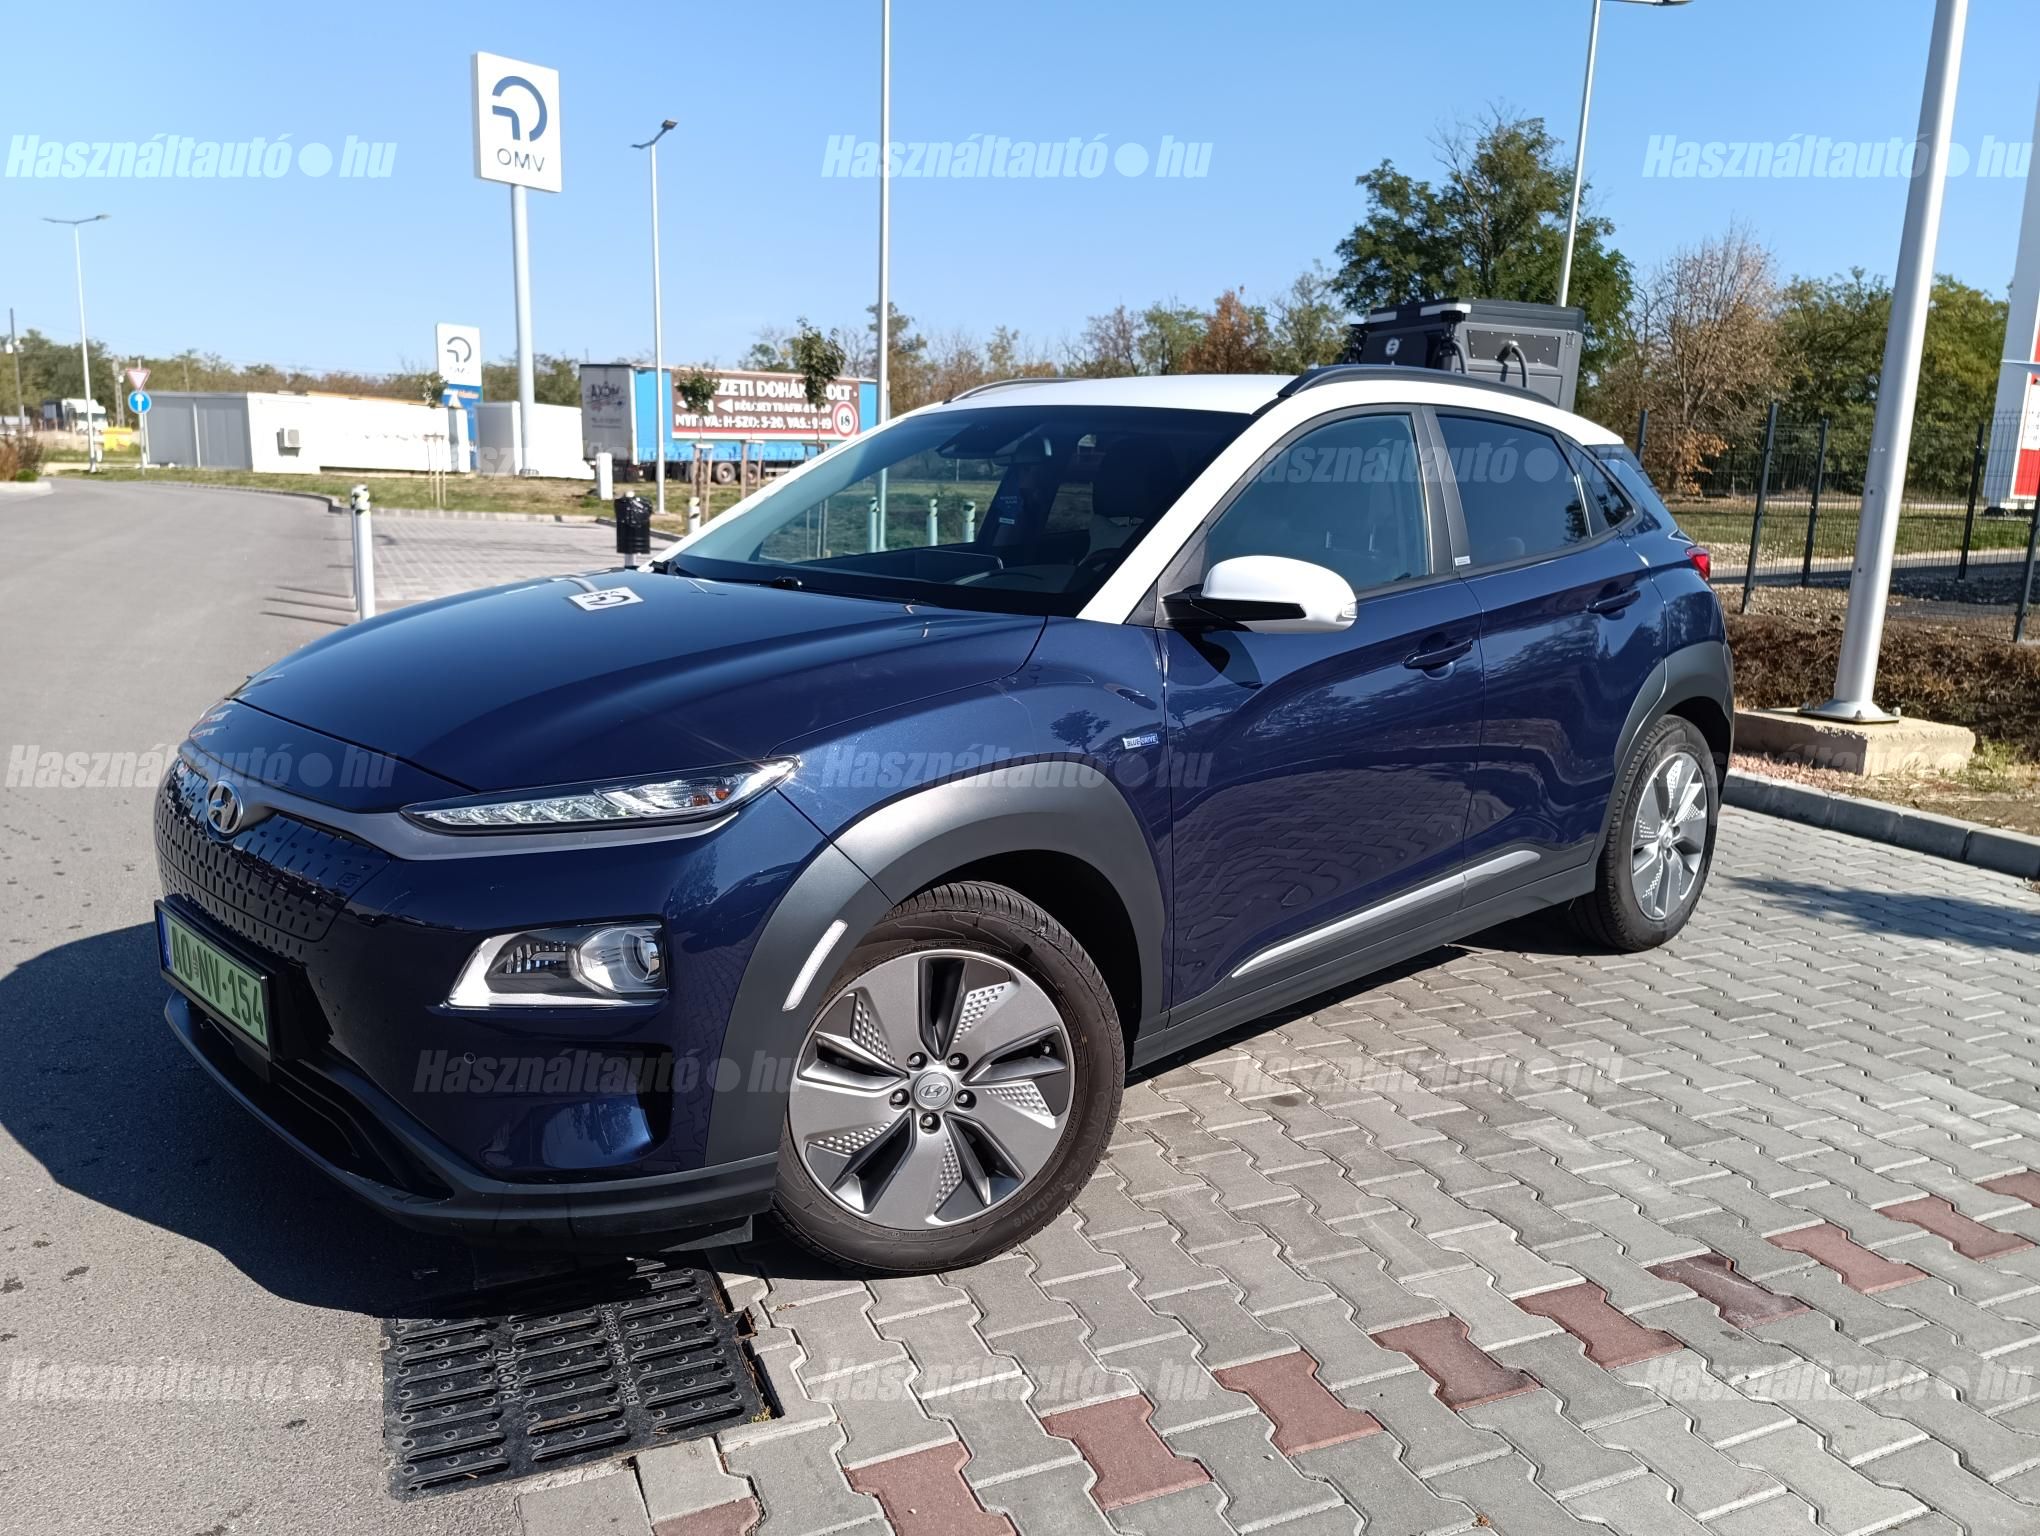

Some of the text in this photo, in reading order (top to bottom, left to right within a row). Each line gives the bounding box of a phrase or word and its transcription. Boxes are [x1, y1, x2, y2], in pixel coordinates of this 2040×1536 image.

[497, 148, 545, 172] OMV
[756, 379, 852, 400] DOHÁNOLT
[840, 416, 850, 426] 18
